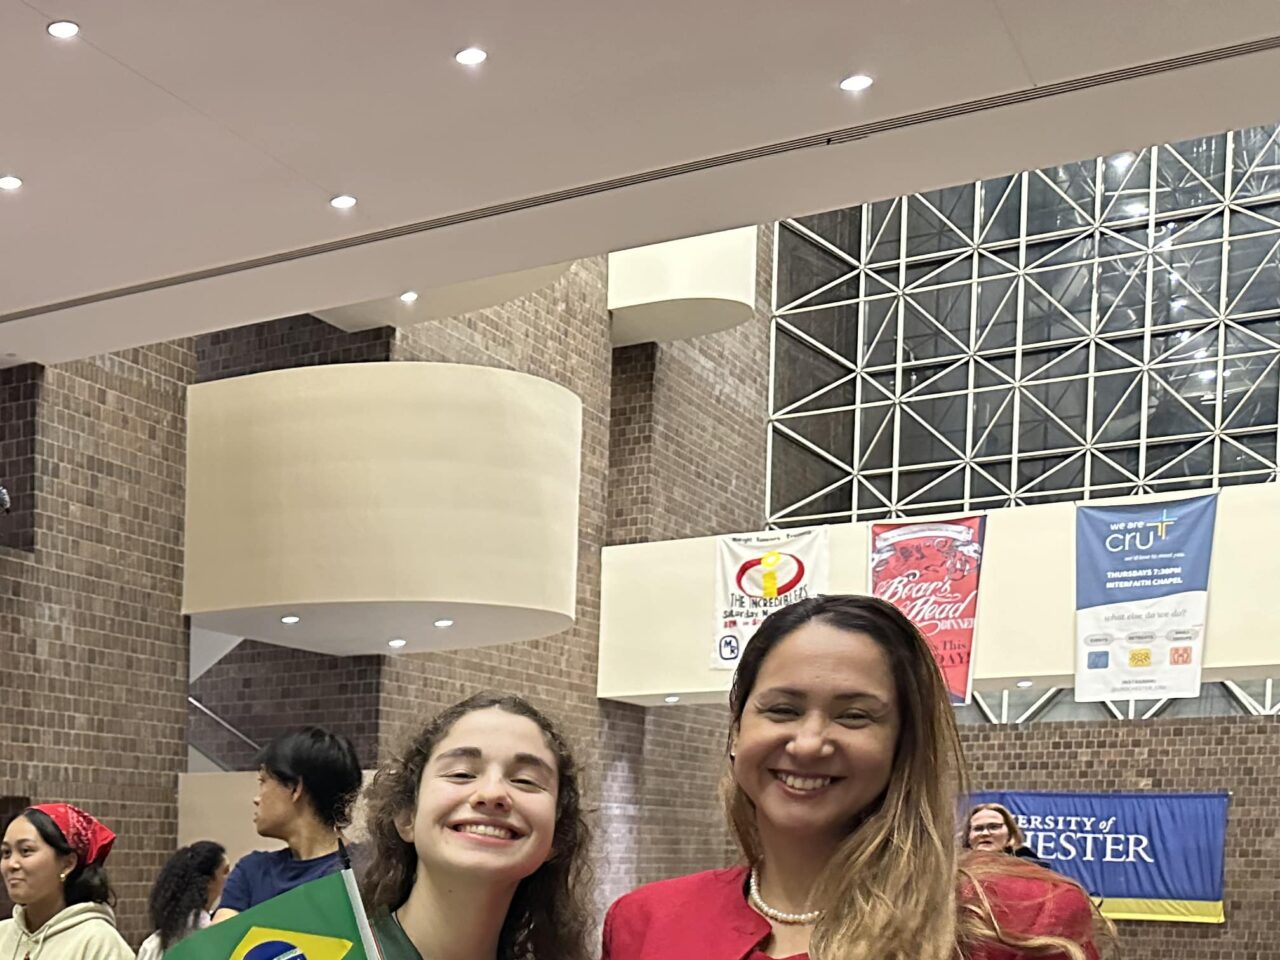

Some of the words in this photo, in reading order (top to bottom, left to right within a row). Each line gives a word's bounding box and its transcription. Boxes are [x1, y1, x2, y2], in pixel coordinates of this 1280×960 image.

[1127, 521, 1144, 529] are
[1106, 531, 1154, 552] cru
[1107, 569, 1152, 579] THURSDAYS
[1106, 580, 1151, 588] INTERFAITH
[1152, 577, 1183, 586] CHAPEL
[731, 593, 745, 608] THE
[903, 591, 977, 621] Head
[943, 640, 966, 651] This
[1013, 814, 1096, 832] ERSITY
[1098, 816, 1116, 833] of
